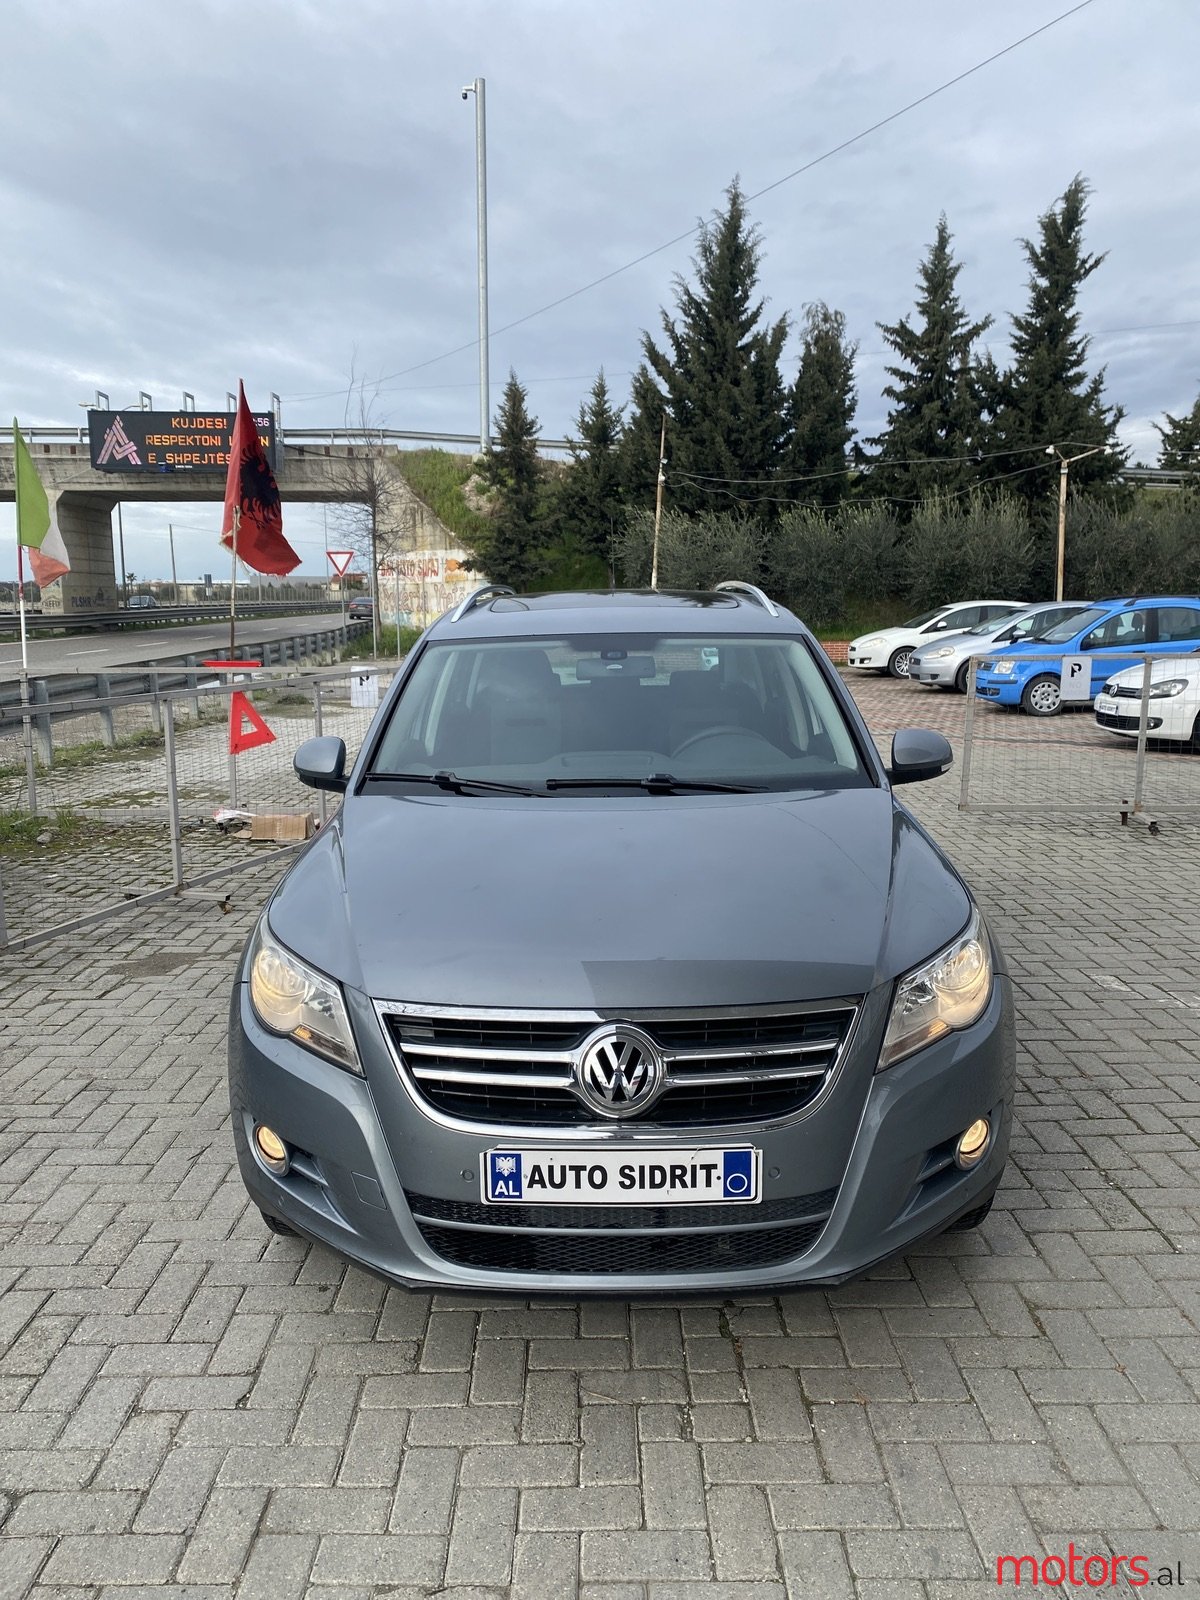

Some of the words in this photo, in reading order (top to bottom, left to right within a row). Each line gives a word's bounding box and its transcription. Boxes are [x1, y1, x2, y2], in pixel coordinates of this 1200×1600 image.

[171, 417, 227, 429] KUJDES!
[253, 417, 270, 427] :56
[145, 435, 222, 447] RESPEKTONI
[148, 453, 157, 464] E
[165, 452, 231, 464] SHPEJTËS
[1070, 663, 1082, 678] P
[526, 1164, 609, 1190] AUTO
[618, 1163, 718, 1190] SIDRIT
[494, 1180, 520, 1196] AL
